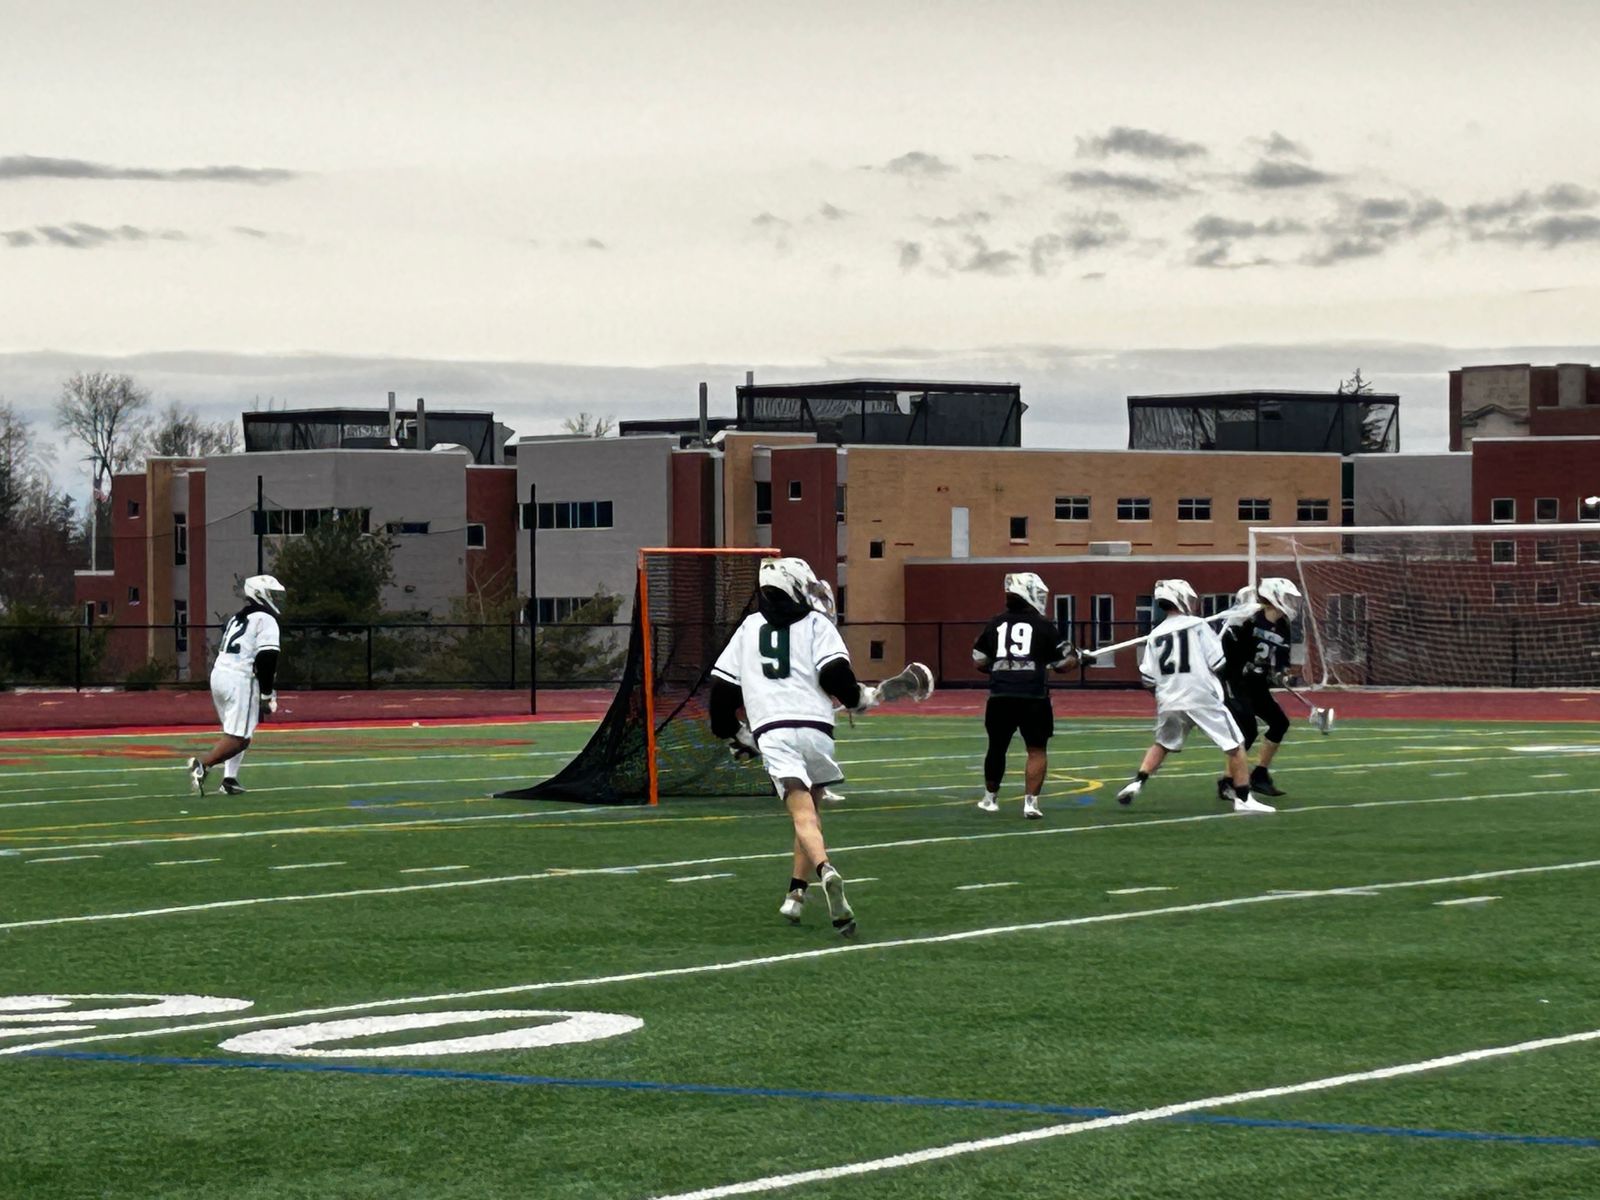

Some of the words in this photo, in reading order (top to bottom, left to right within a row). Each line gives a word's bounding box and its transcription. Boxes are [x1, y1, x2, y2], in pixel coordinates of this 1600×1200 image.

[759, 624, 791, 679] 9
[996, 621, 1033, 658] 19
[1155, 629, 1191, 675] 21
